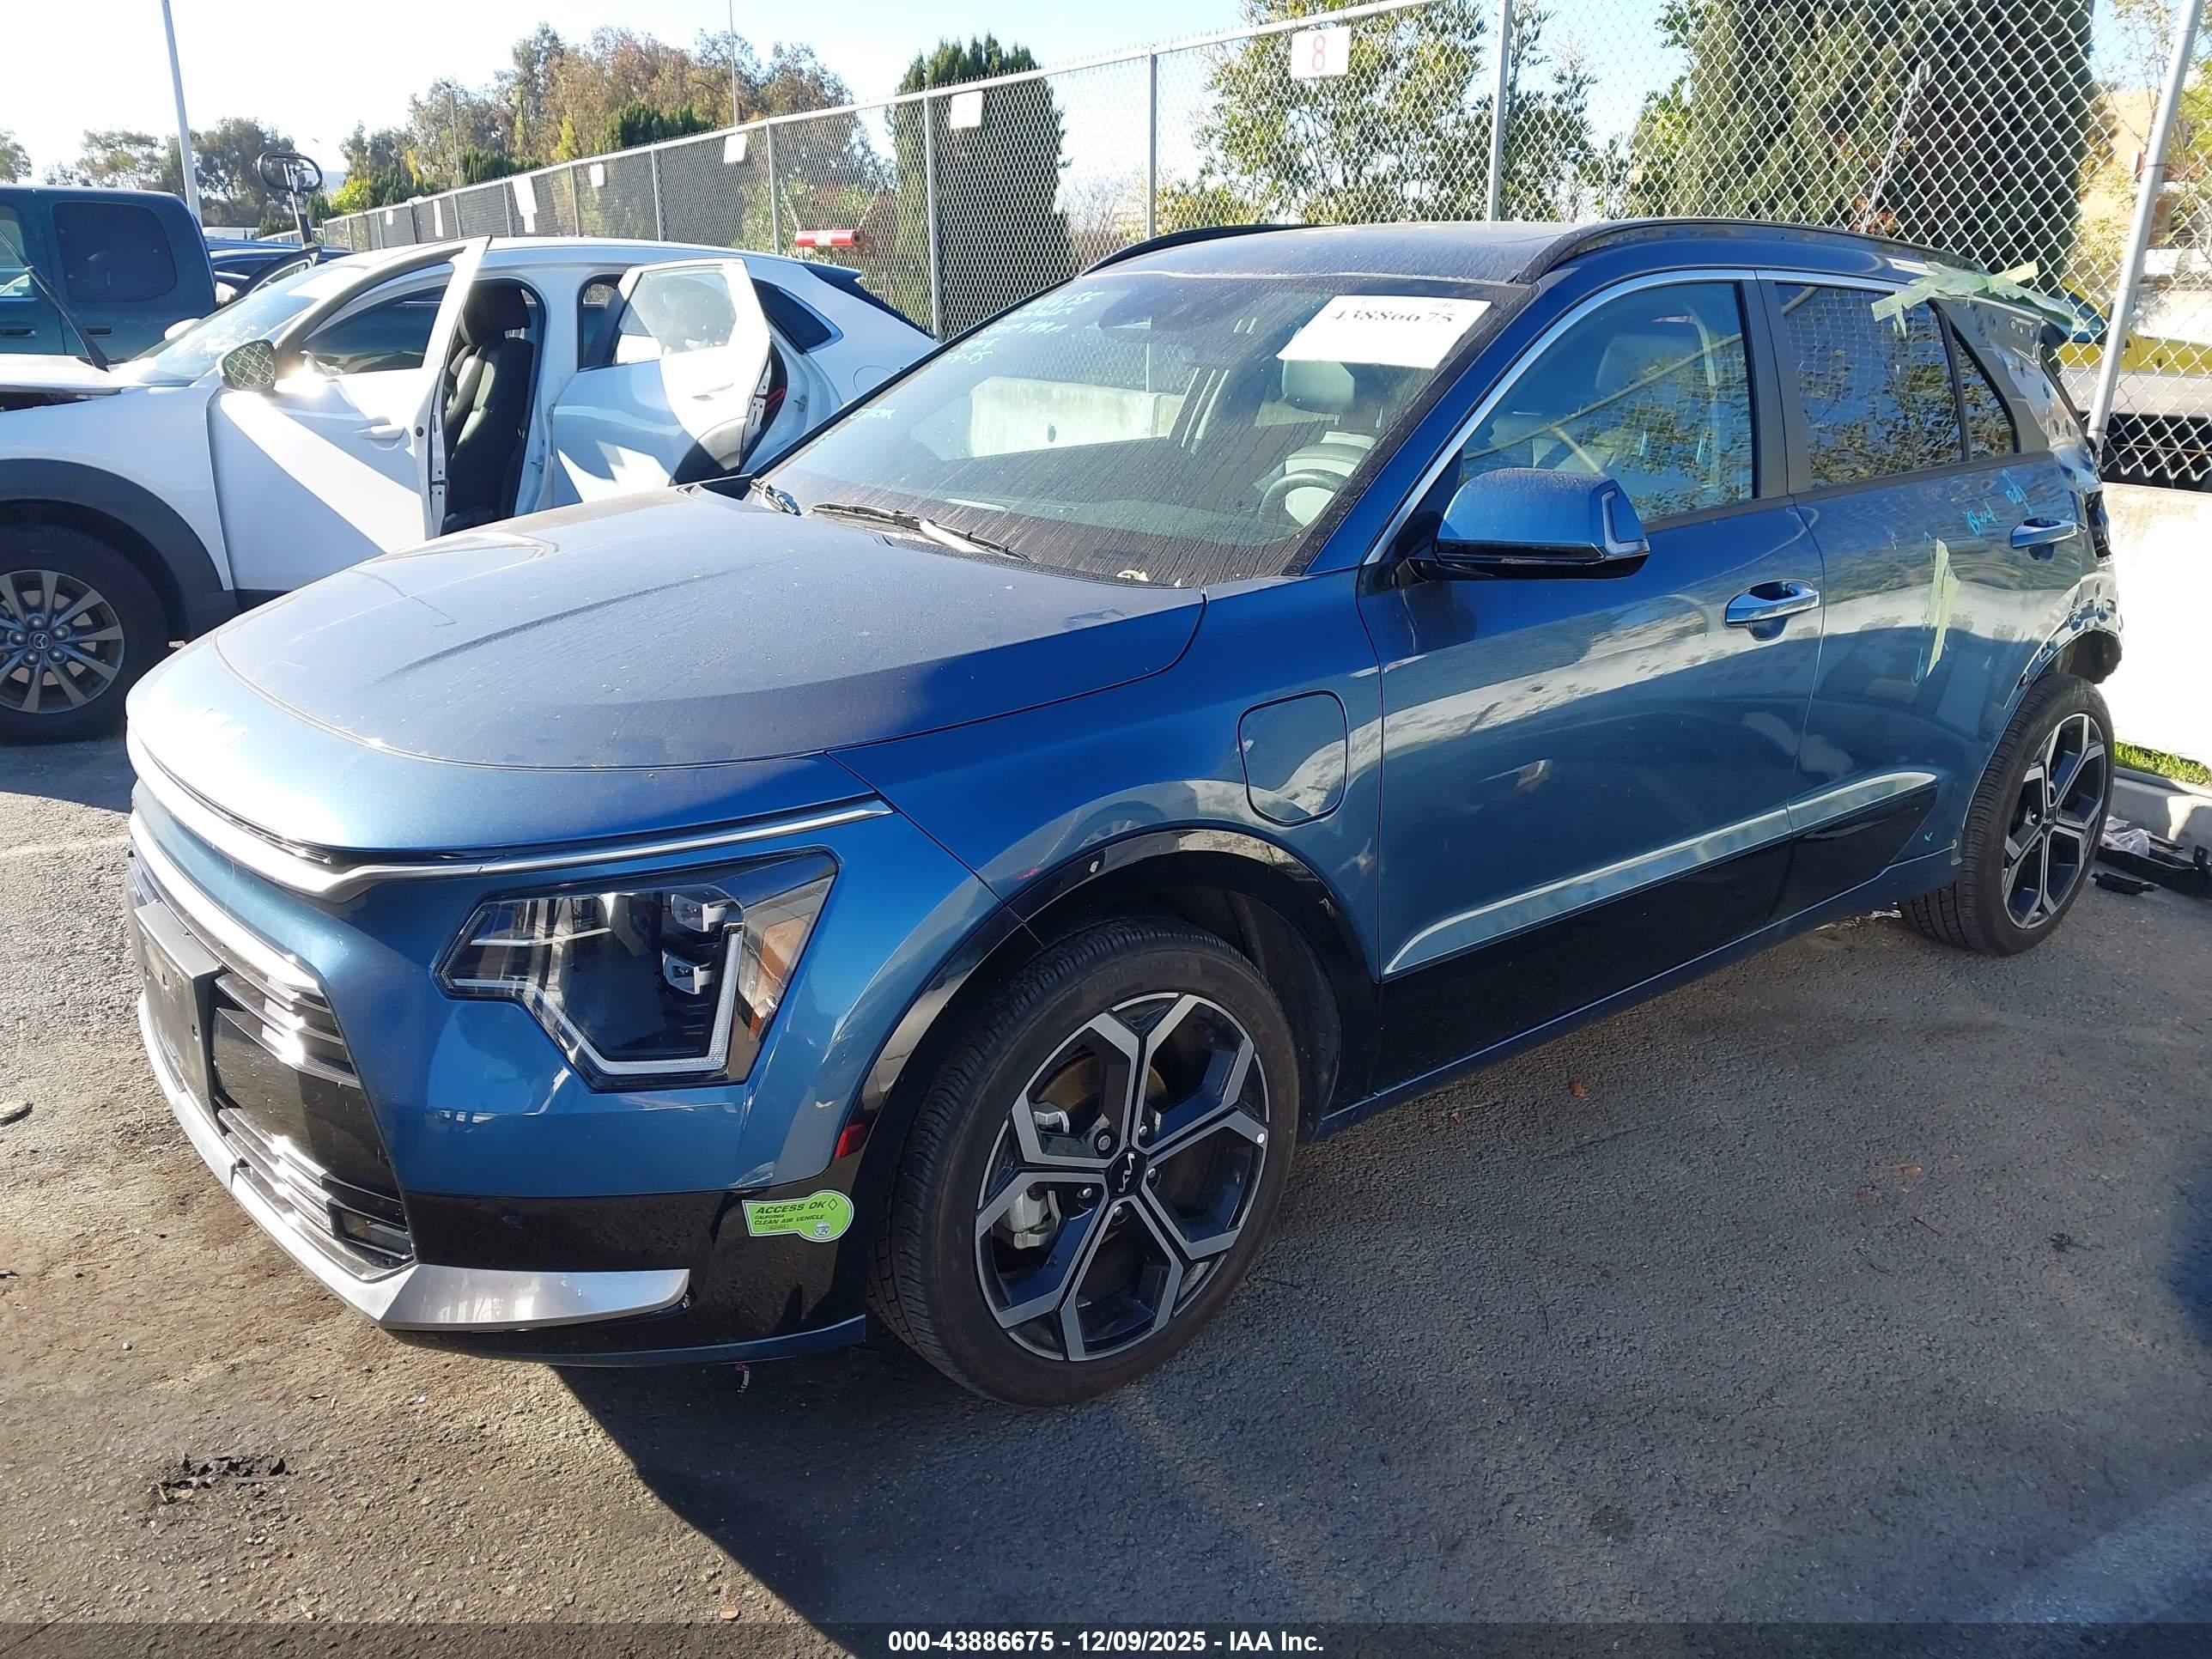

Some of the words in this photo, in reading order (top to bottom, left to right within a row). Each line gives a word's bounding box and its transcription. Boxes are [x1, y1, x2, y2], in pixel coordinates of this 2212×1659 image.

[1311, 34, 1327, 72] 8
[756, 1203, 805, 1214] ACCESS
[808, 1200, 827, 1210] OK
